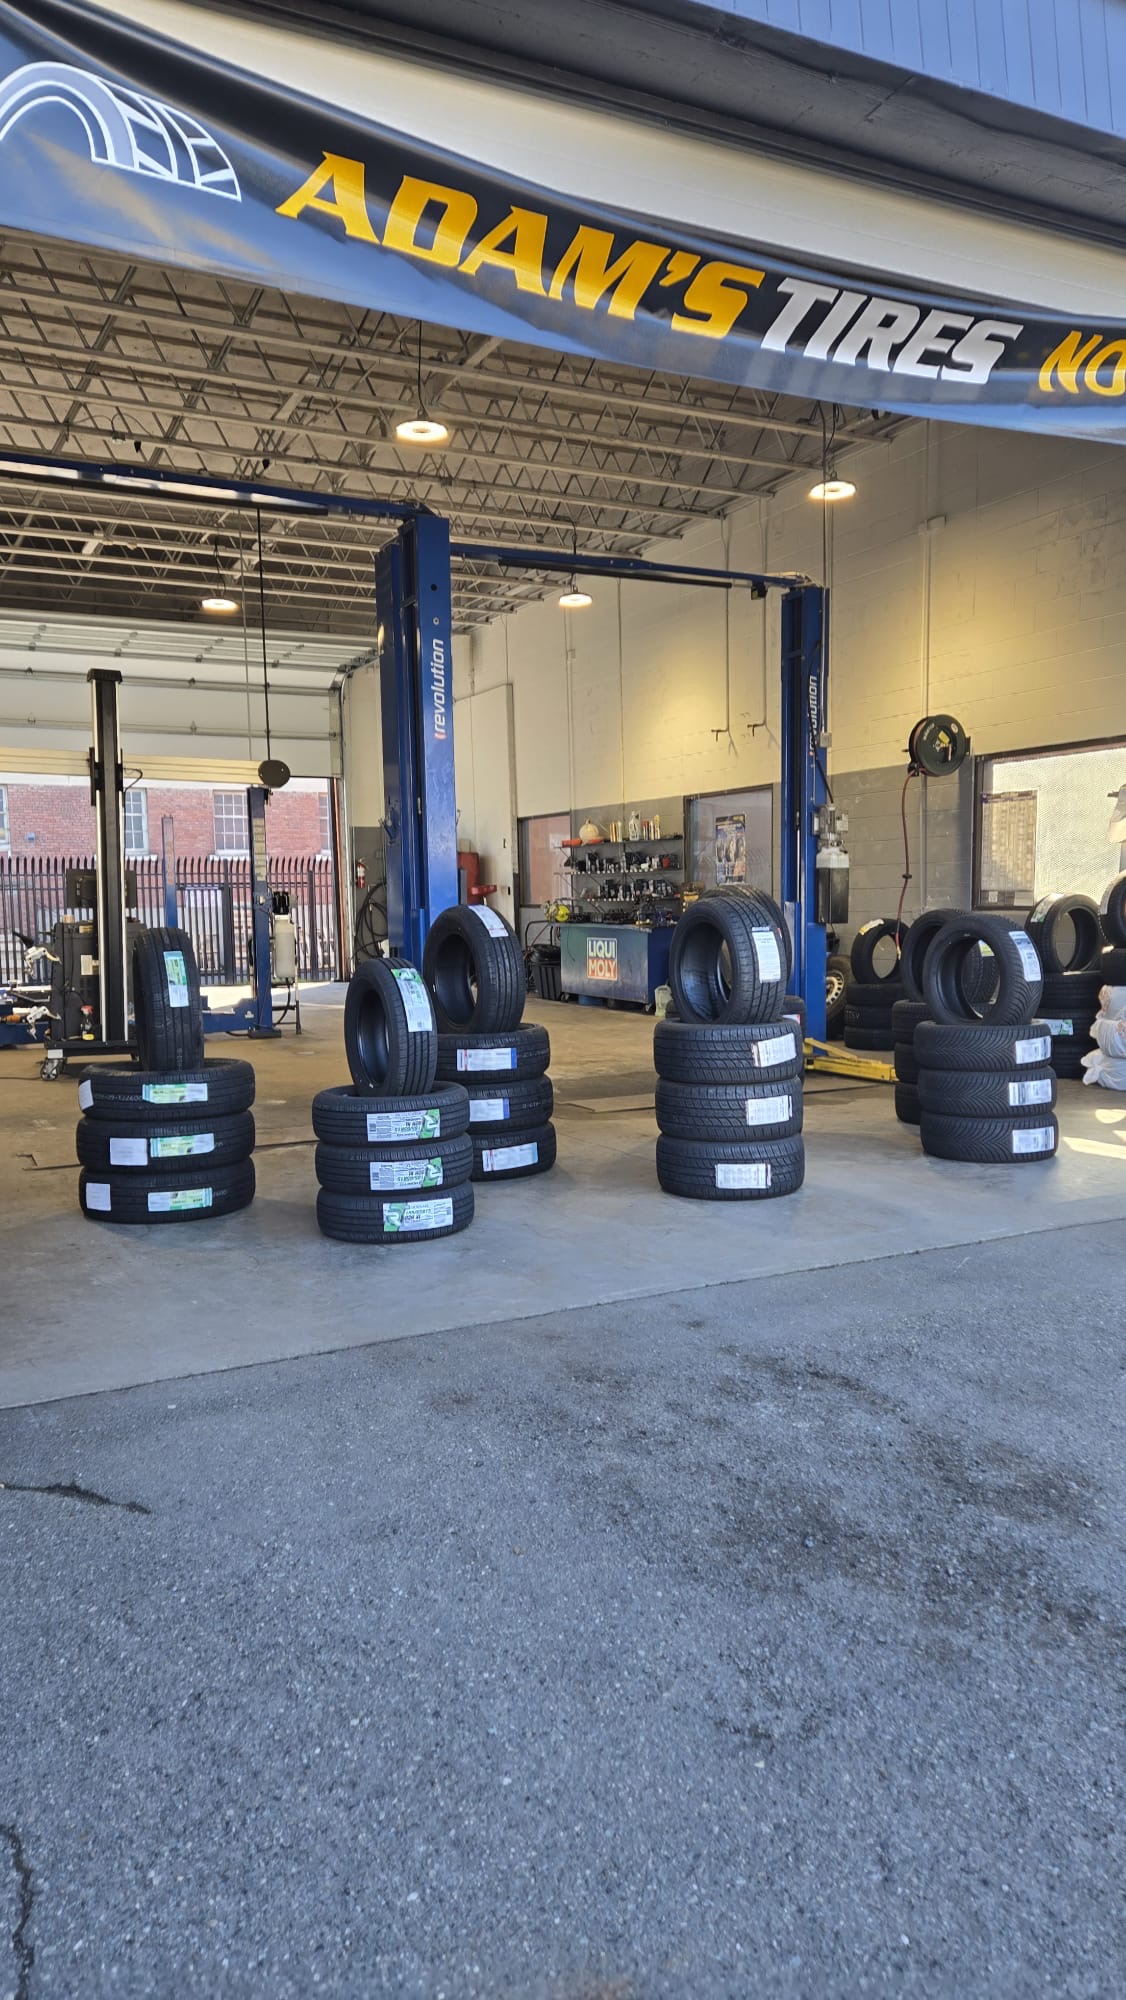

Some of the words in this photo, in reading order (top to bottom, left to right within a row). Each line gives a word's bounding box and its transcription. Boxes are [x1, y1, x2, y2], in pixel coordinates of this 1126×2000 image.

[275, 150, 765, 340] ADAM'S
[761, 277, 1024, 385] TIRES
[1038, 329, 1126, 397] NO
[431, 638, 444, 733] revolution
[807, 675, 818, 750] rolution
[588, 940, 615, 958] LIQUI
[588, 959, 616, 977] MOLY
